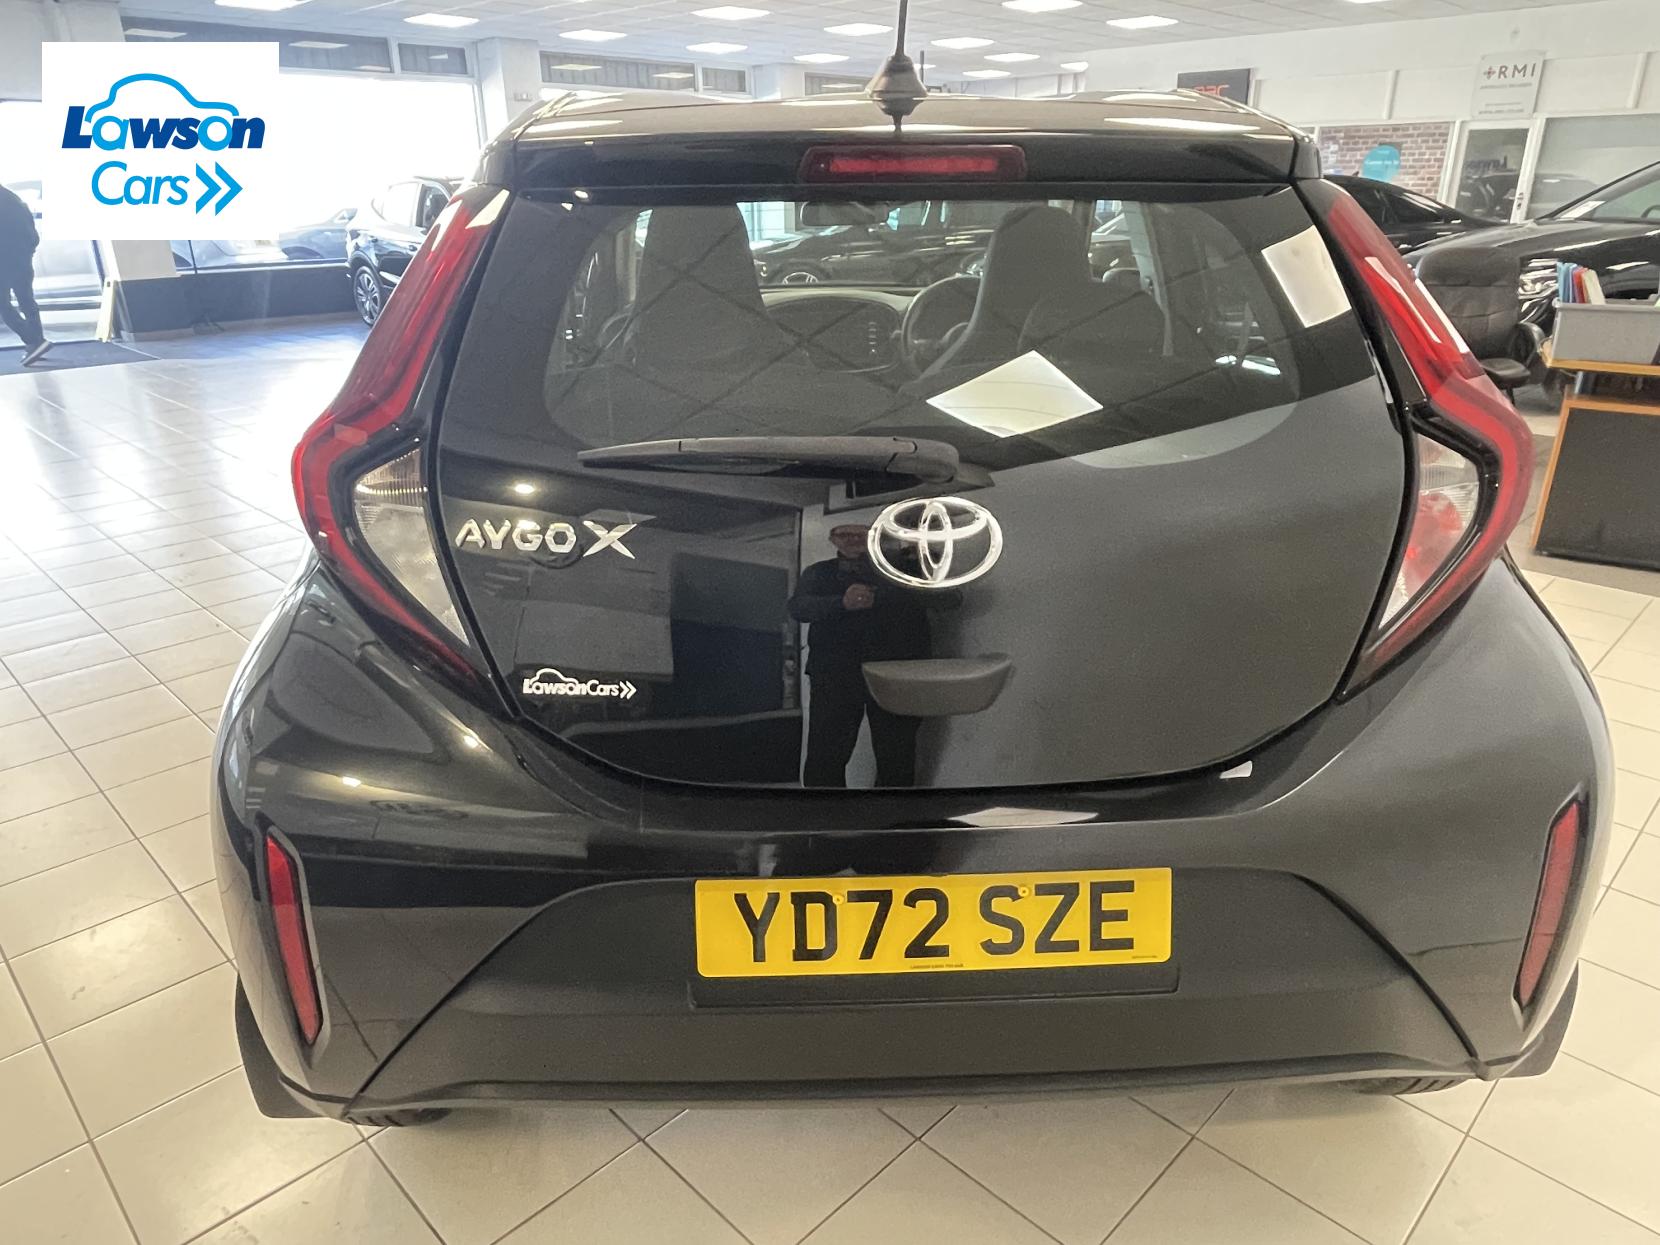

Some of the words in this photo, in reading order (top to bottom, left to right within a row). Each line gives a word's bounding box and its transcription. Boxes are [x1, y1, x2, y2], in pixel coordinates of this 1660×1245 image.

[1498, 63, 1536, 79] RMI
[455, 518, 577, 554] AYGO
[582, 519, 637, 560] X
[734, 888, 950, 962] YD72
[979, 880, 1135, 956] SZE
